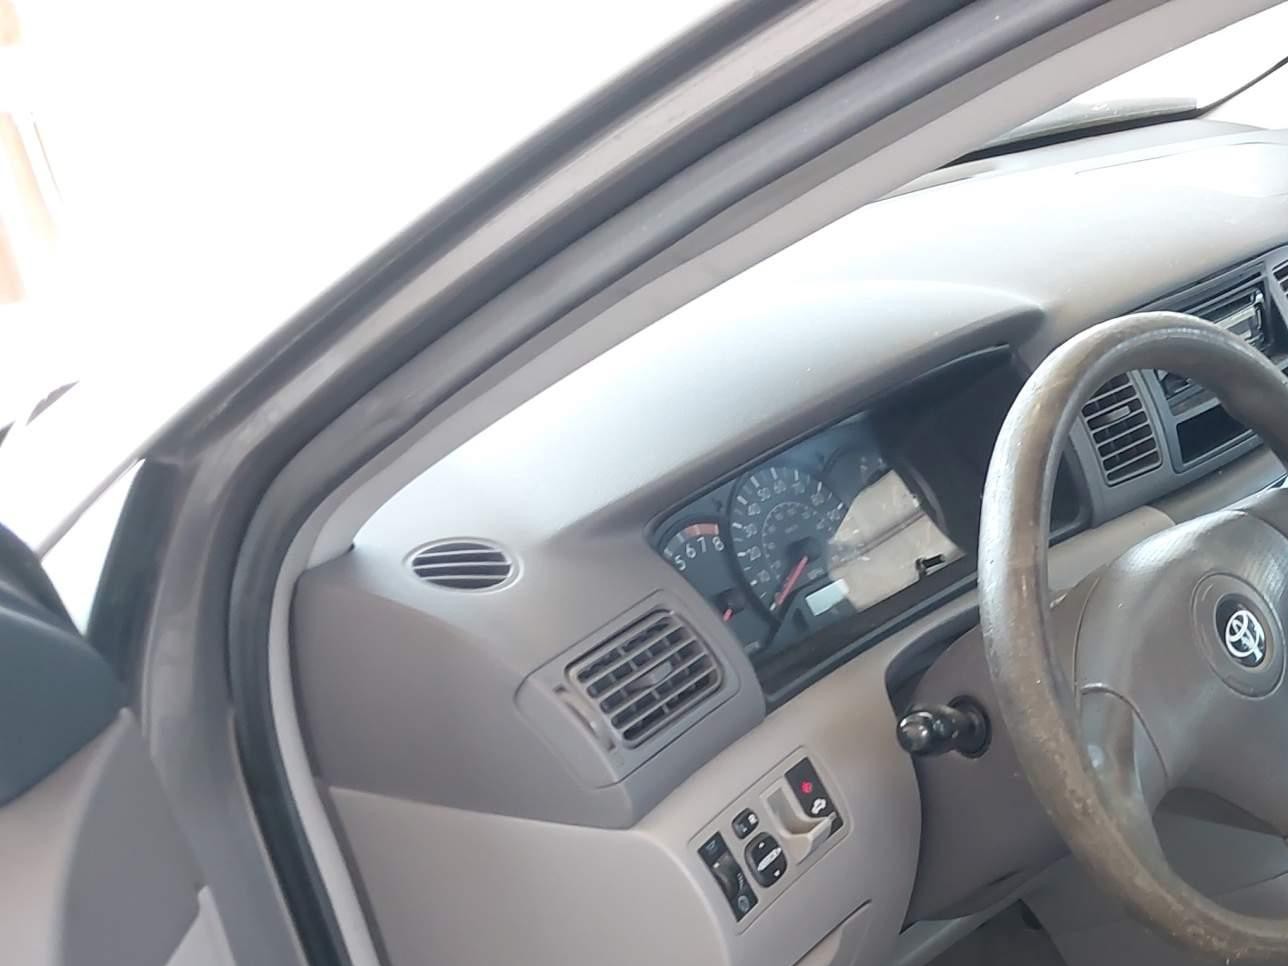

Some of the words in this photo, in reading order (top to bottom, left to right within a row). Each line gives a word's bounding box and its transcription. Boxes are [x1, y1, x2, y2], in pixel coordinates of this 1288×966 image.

[757, 487, 771, 501] 50
[743, 523, 758, 538] 30
[675, 554, 686, 571] 5
[685, 543, 697, 559] 6
[696, 536, 707, 553] 7
[712, 536, 725, 551] 8
[746, 546, 762, 561] 20
